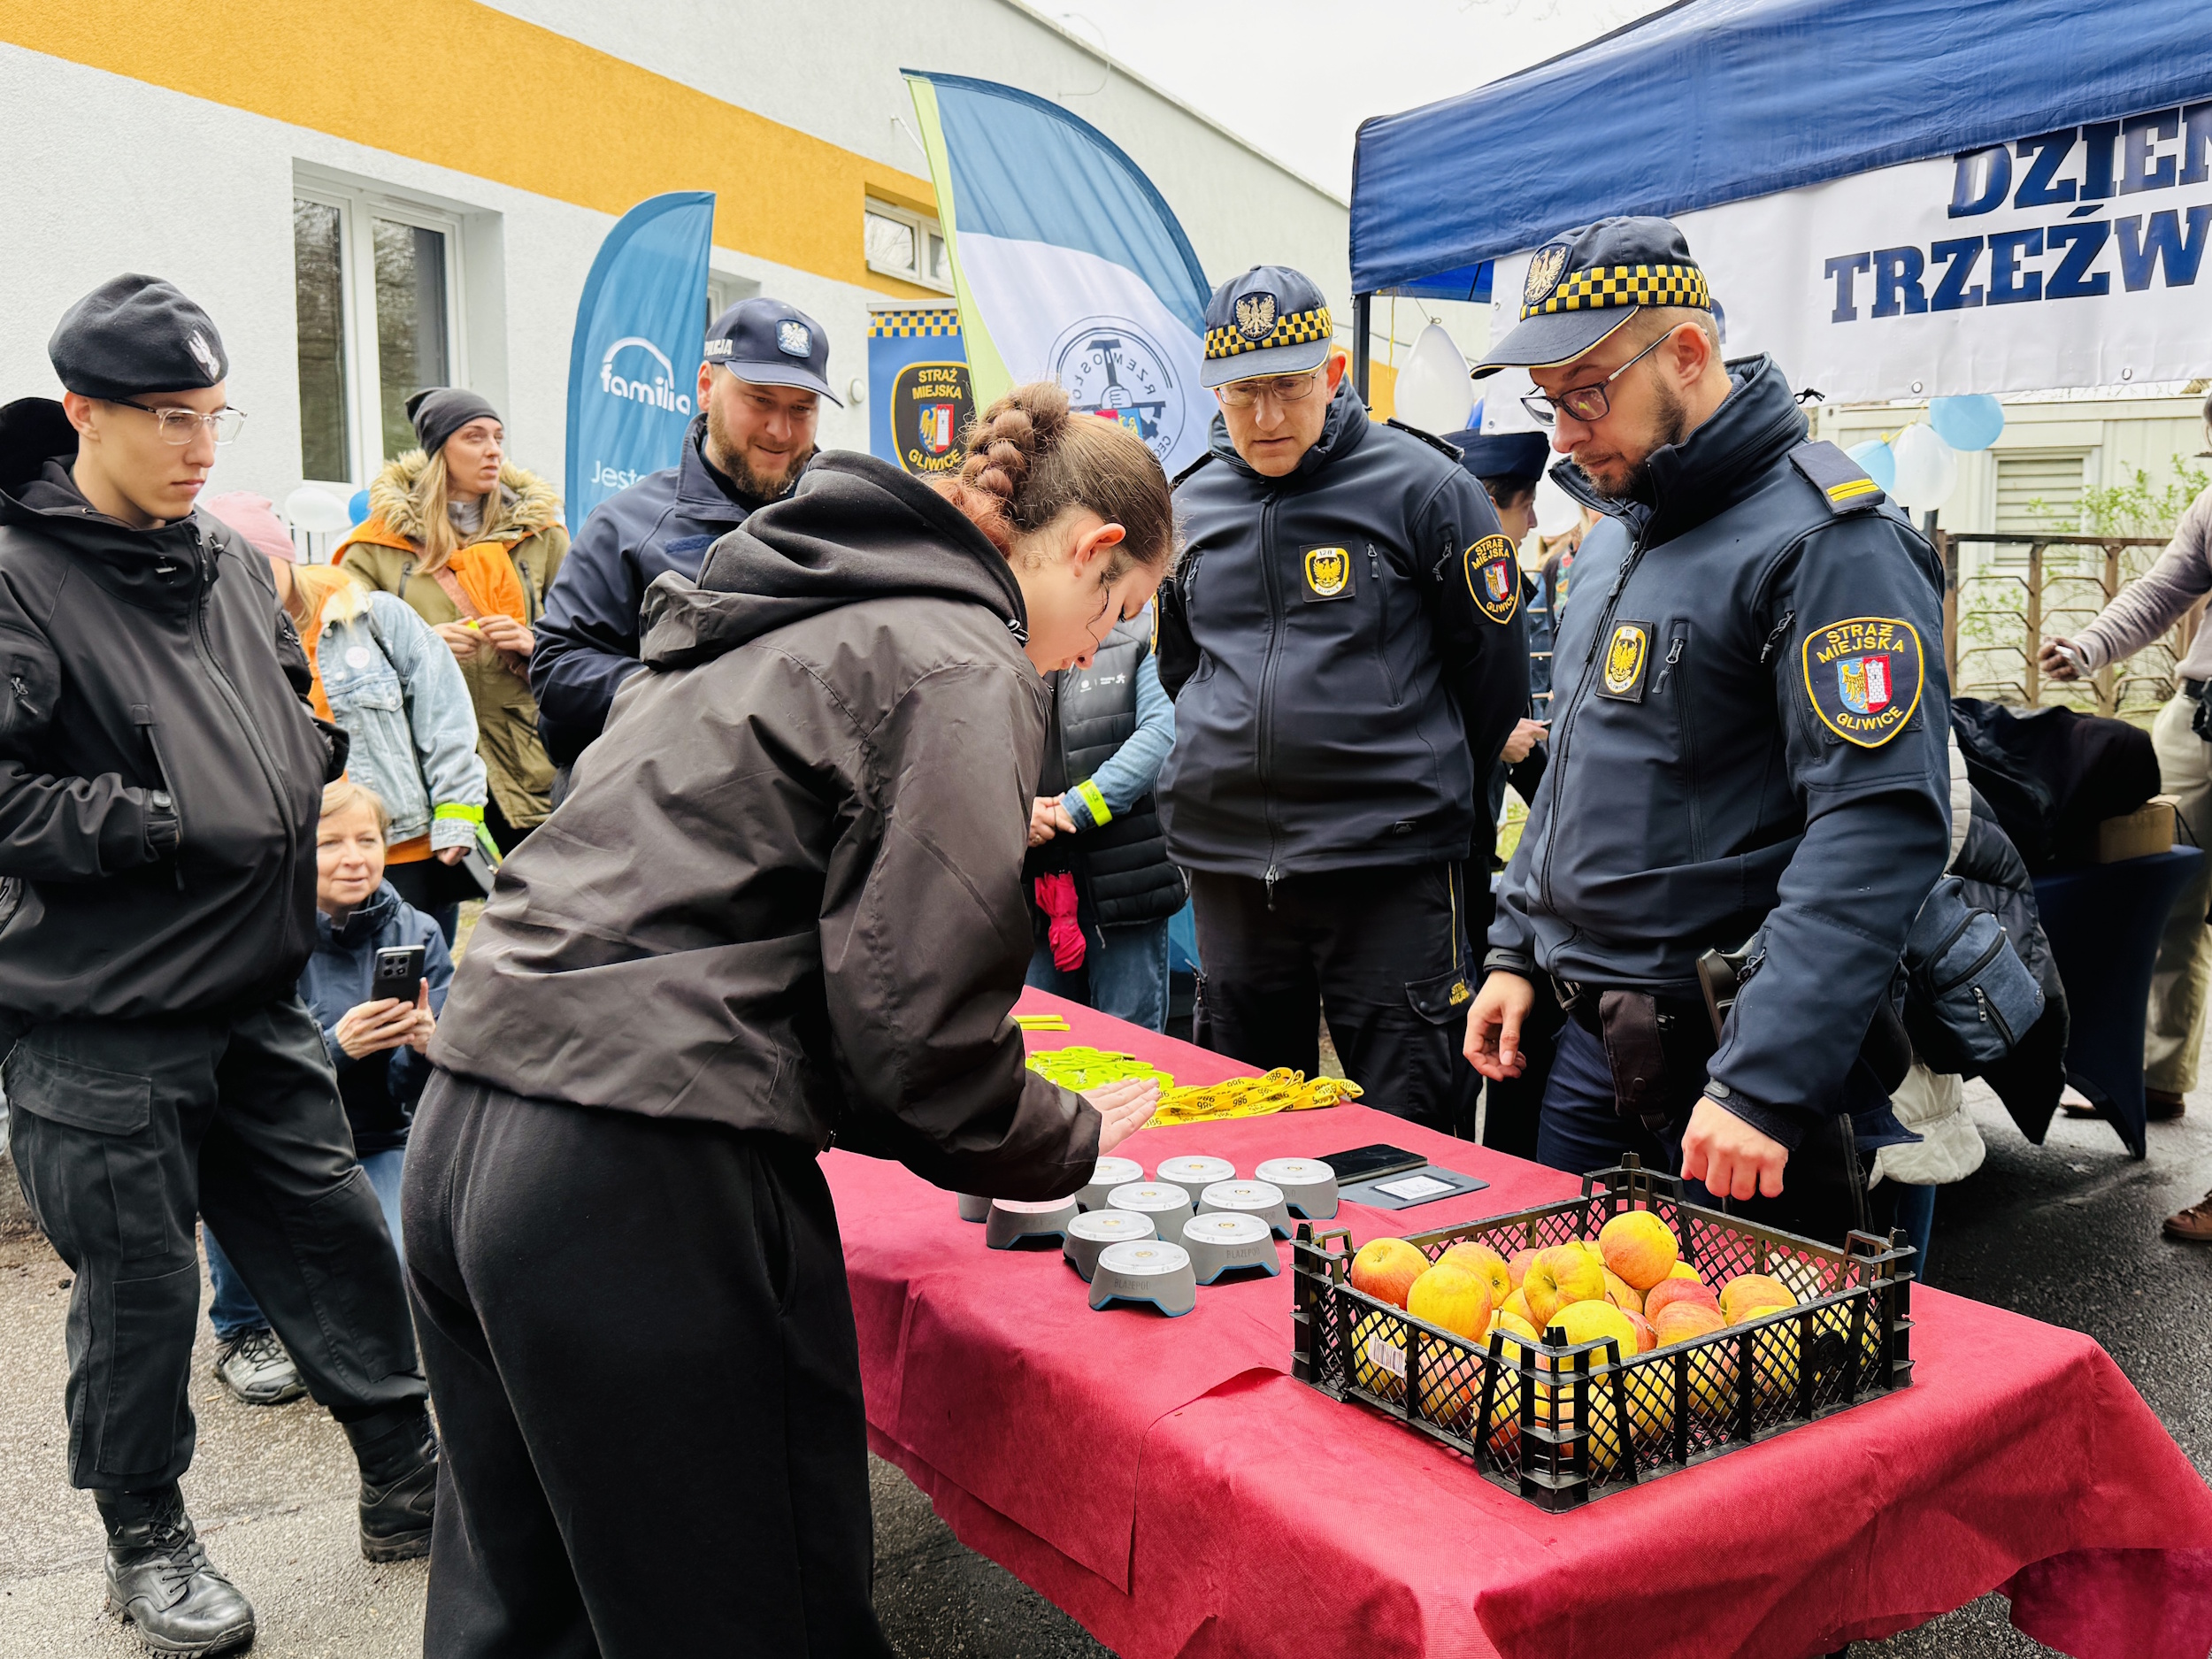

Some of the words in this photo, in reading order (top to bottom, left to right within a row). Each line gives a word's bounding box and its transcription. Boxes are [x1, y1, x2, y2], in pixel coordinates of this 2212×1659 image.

[1824, 204, 2212, 323] TRZEŹW
[918, 368, 957, 383] STRAŻ
[600, 363, 691, 416] familia
[912, 384, 962, 400] MIEJSKA
[909, 449, 962, 472] GLIWICE
[1471, 549, 1509, 570] MIEJSKA
[1486, 594, 1515, 613] GLIWICE
[1816, 636, 1904, 664] MIEJSKA
[1837, 706, 1904, 731] GLIWICE
[1266, 1070, 1282, 1083] 986
[1318, 1085, 1337, 1094] 986
[1233, 1094, 1248, 1107] 986
